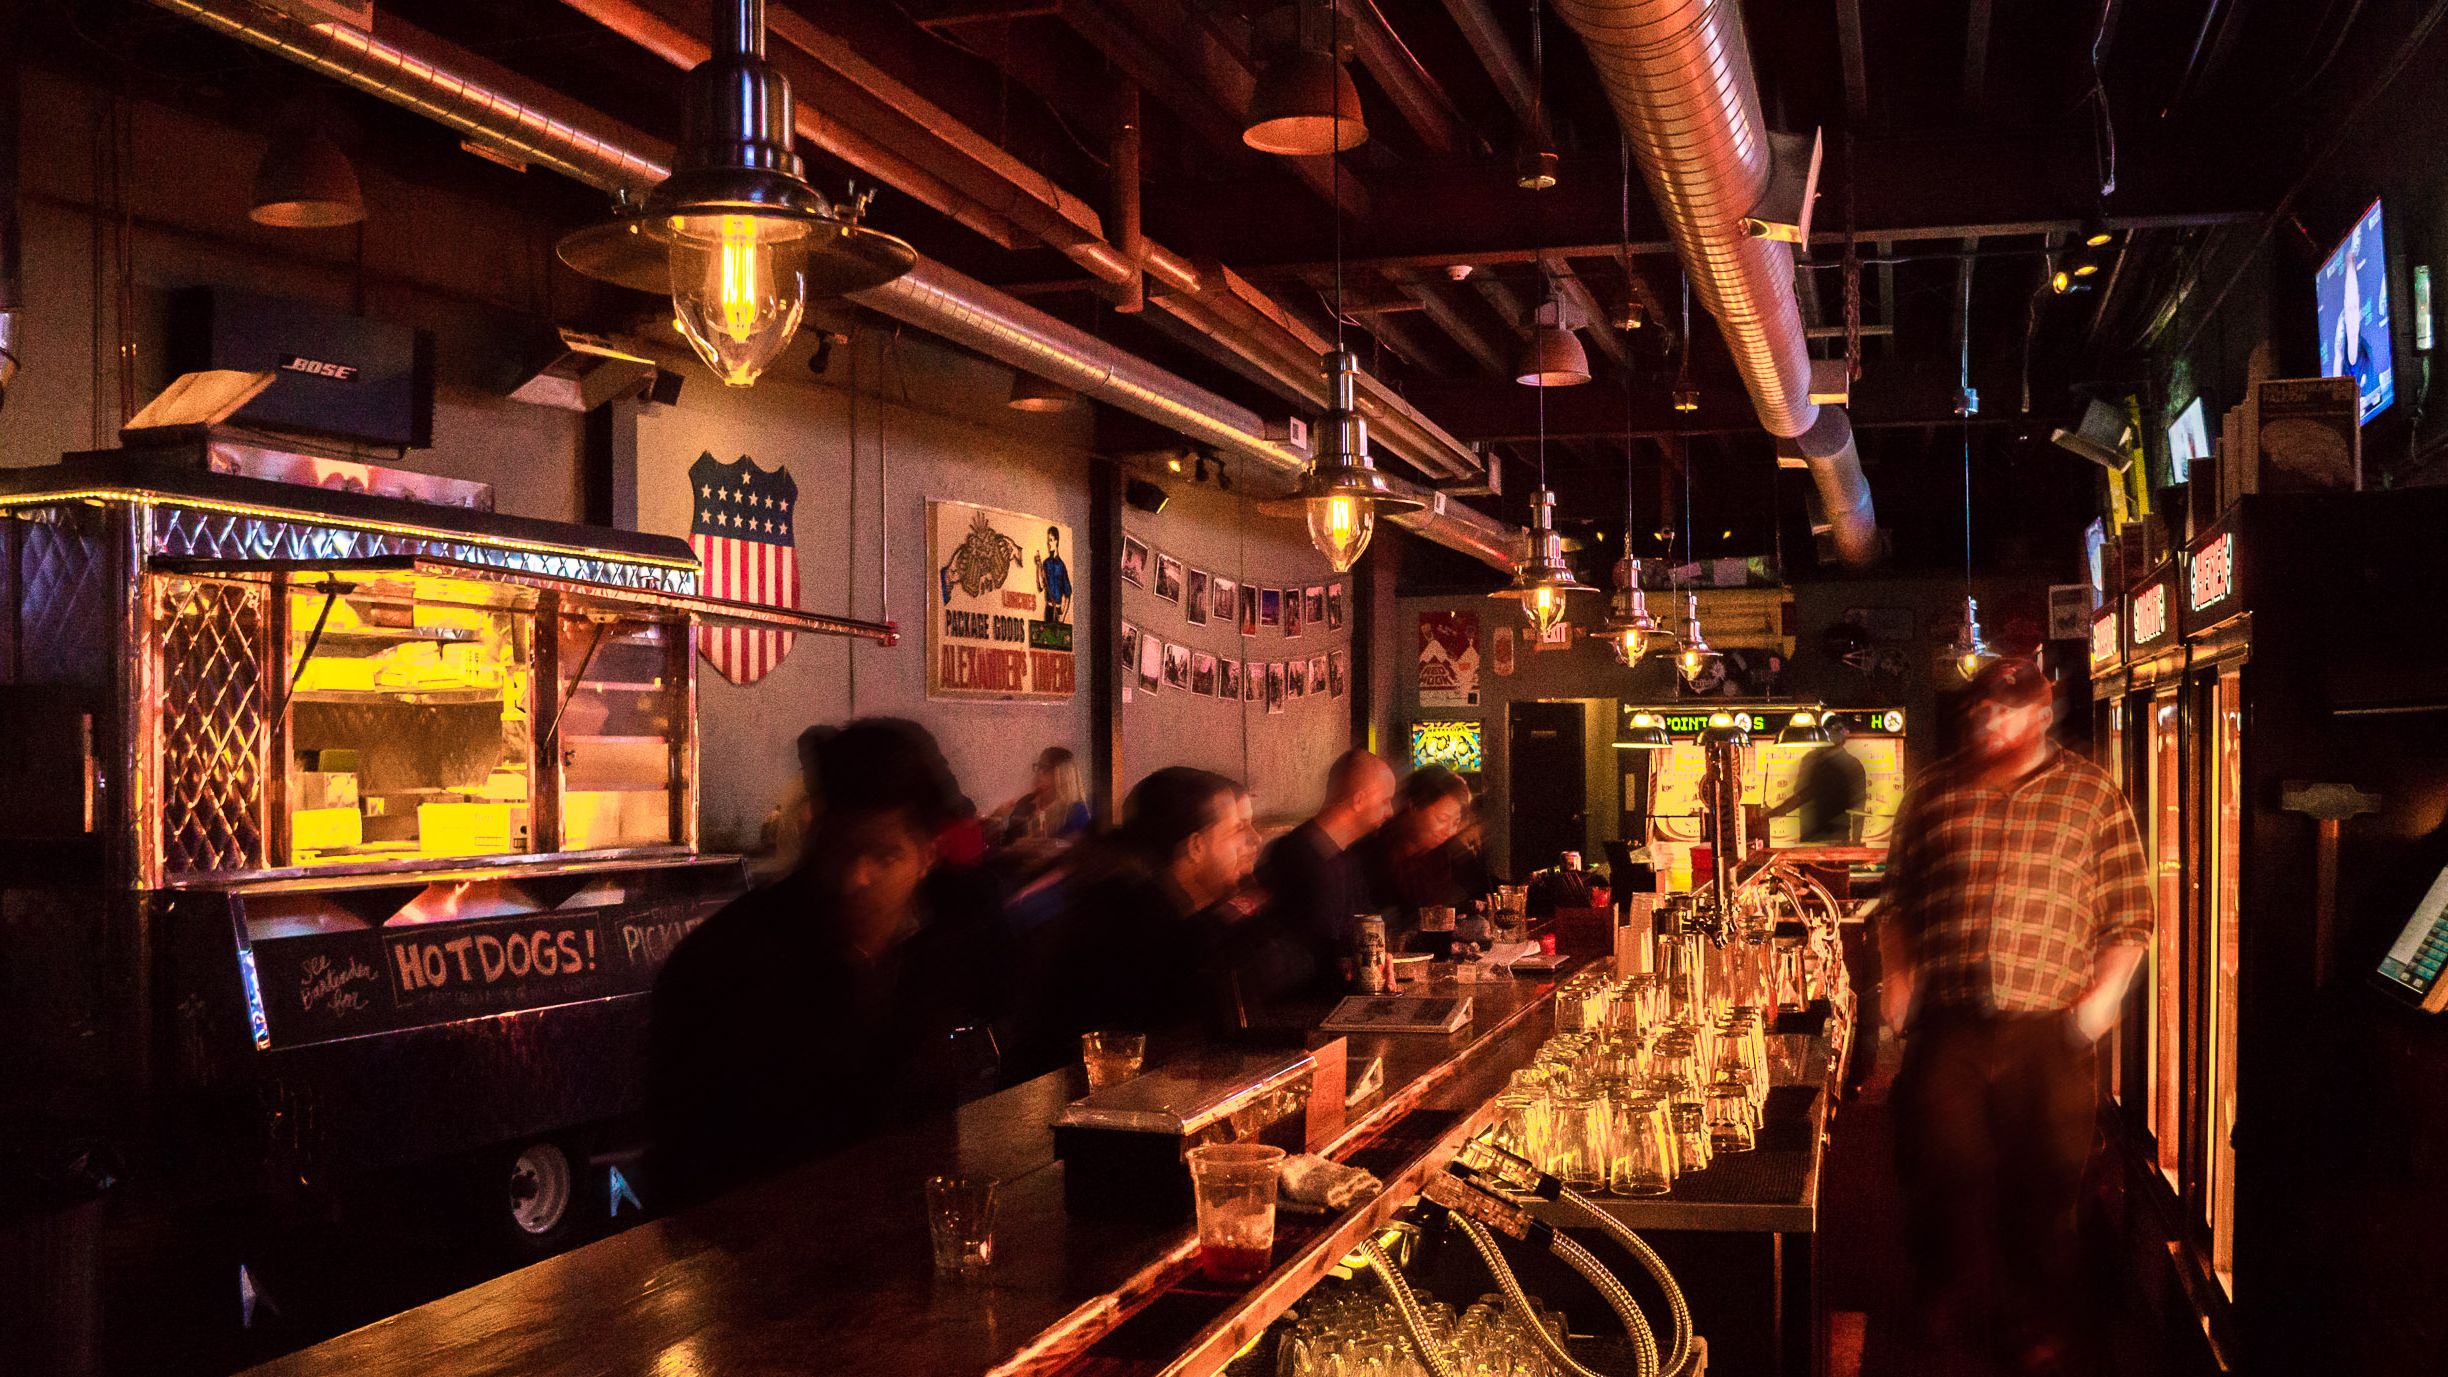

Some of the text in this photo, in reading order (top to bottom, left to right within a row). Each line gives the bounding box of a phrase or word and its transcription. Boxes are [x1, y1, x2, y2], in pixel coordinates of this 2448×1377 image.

[281, 357, 358, 380] BOSE
[945, 609, 989, 639] PACKAGE
[993, 614, 1026, 643] GOODS
[1422, 666, 1446, 675] RED
[1418, 675, 1453, 686] HOOK
